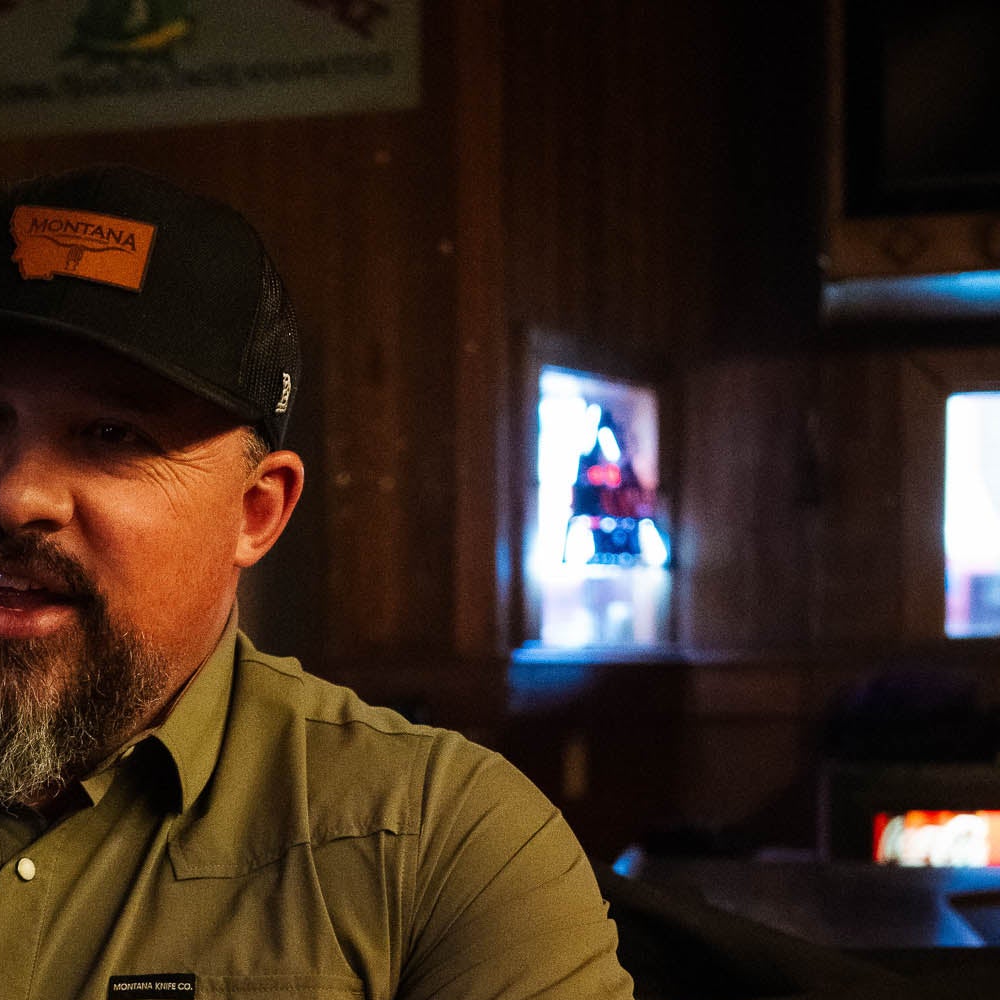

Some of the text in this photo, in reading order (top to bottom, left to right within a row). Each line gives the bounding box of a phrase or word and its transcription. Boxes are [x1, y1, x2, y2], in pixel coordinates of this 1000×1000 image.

[29, 217, 137, 252] MONTANA
[113, 982, 193, 991] MONTANA KNIFE CO.
